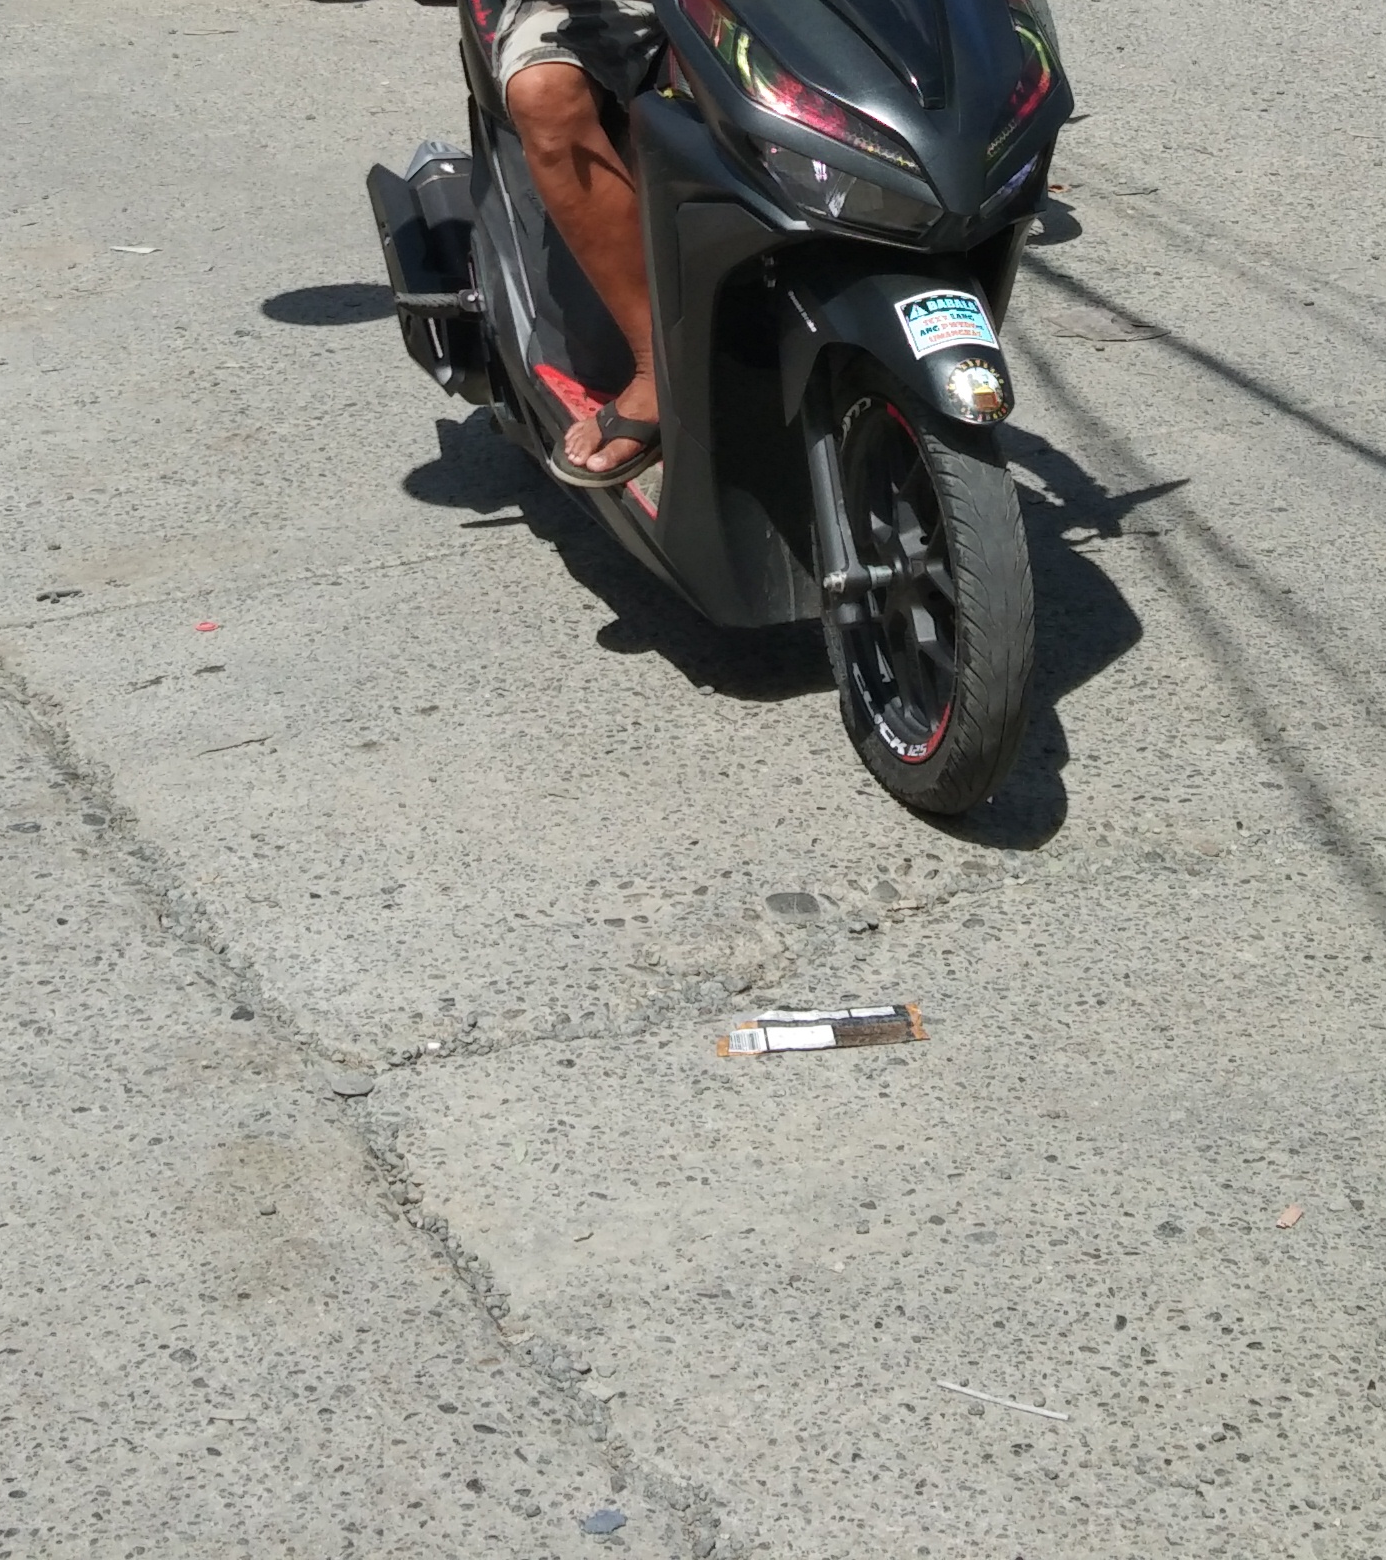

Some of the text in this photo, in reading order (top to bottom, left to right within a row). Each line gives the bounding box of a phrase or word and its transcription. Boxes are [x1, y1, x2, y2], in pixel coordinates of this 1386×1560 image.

[925, 298, 979, 312] BABALA
[919, 325, 940, 337] ANG
[906, 742, 928, 757] 125
